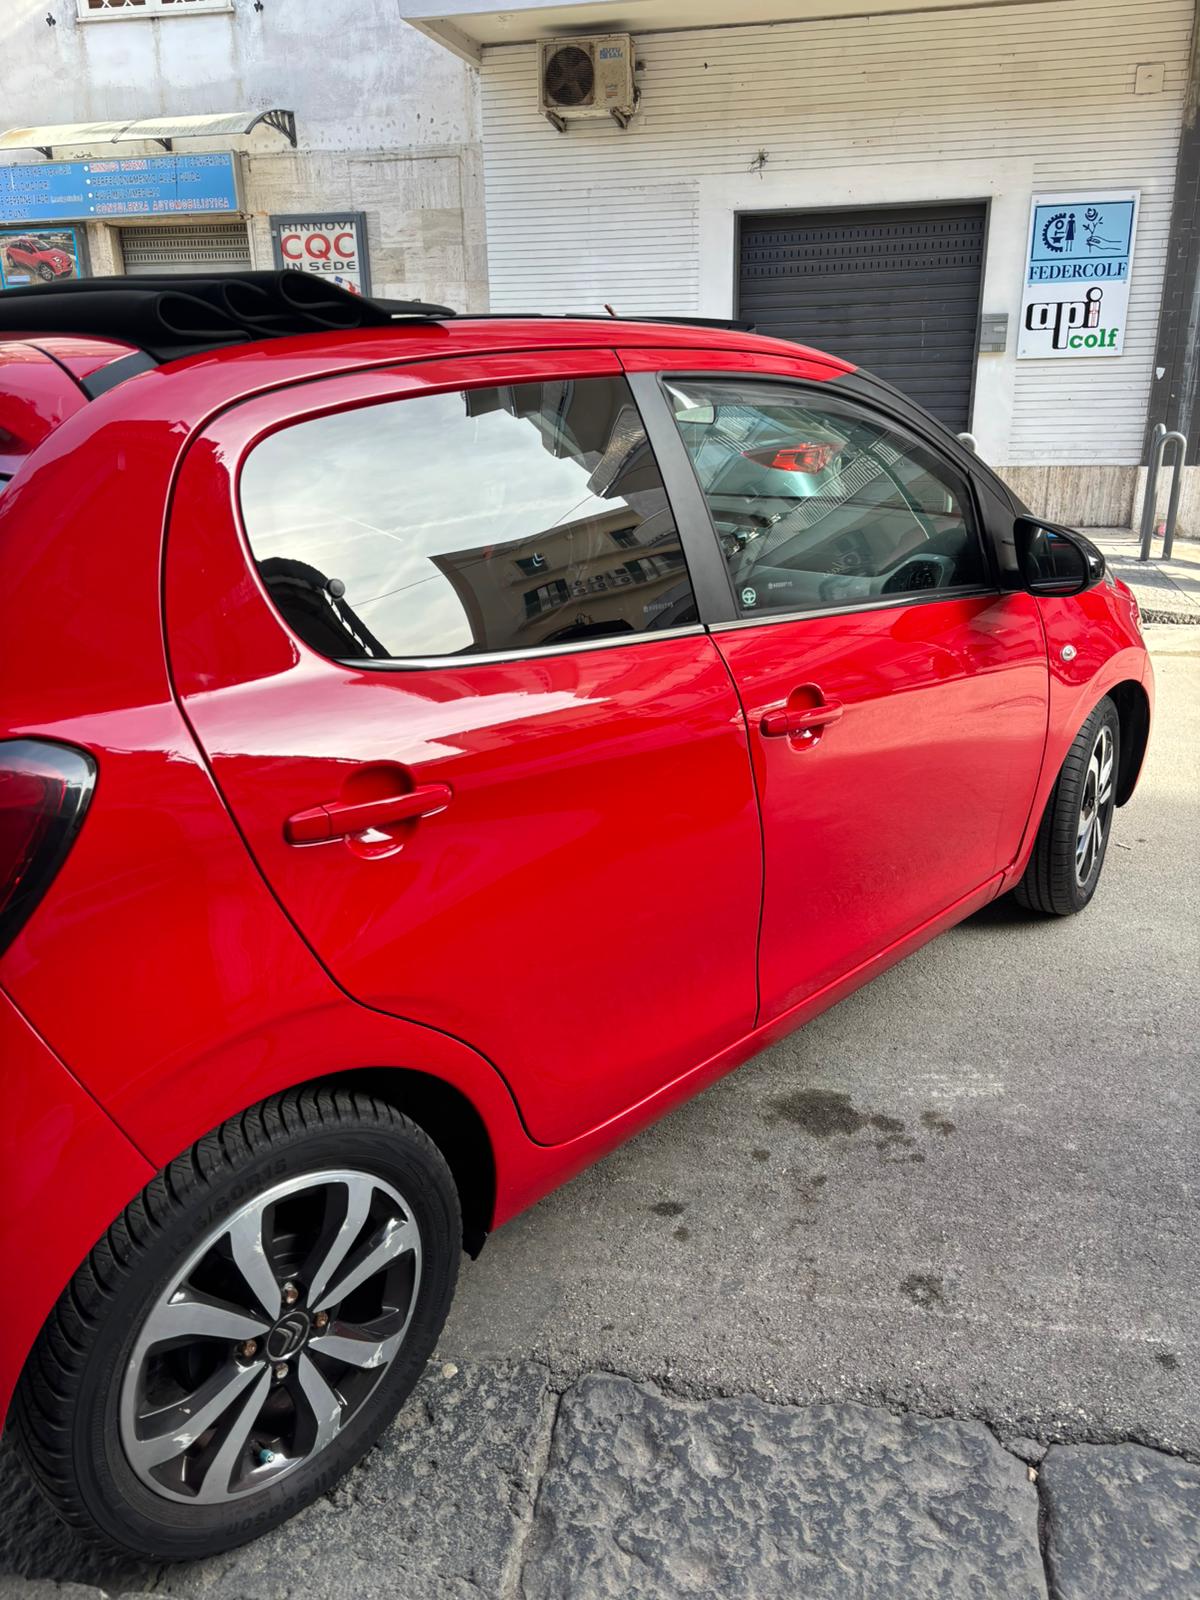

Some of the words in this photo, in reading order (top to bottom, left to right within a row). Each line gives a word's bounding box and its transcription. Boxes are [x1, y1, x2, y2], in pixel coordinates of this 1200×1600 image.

[152, 197, 230, 211] AUTOMOBILISTICA
[282, 222, 354, 232] RINNOVI
[281, 232, 355, 261] CQC
[286, 262, 303, 271] IN
[309, 261, 356, 271] SEDE
[1029, 262, 1128, 281] FEDERCOLF
[1025, 286, 1104, 350] api
[1069, 328, 1119, 349] colf
